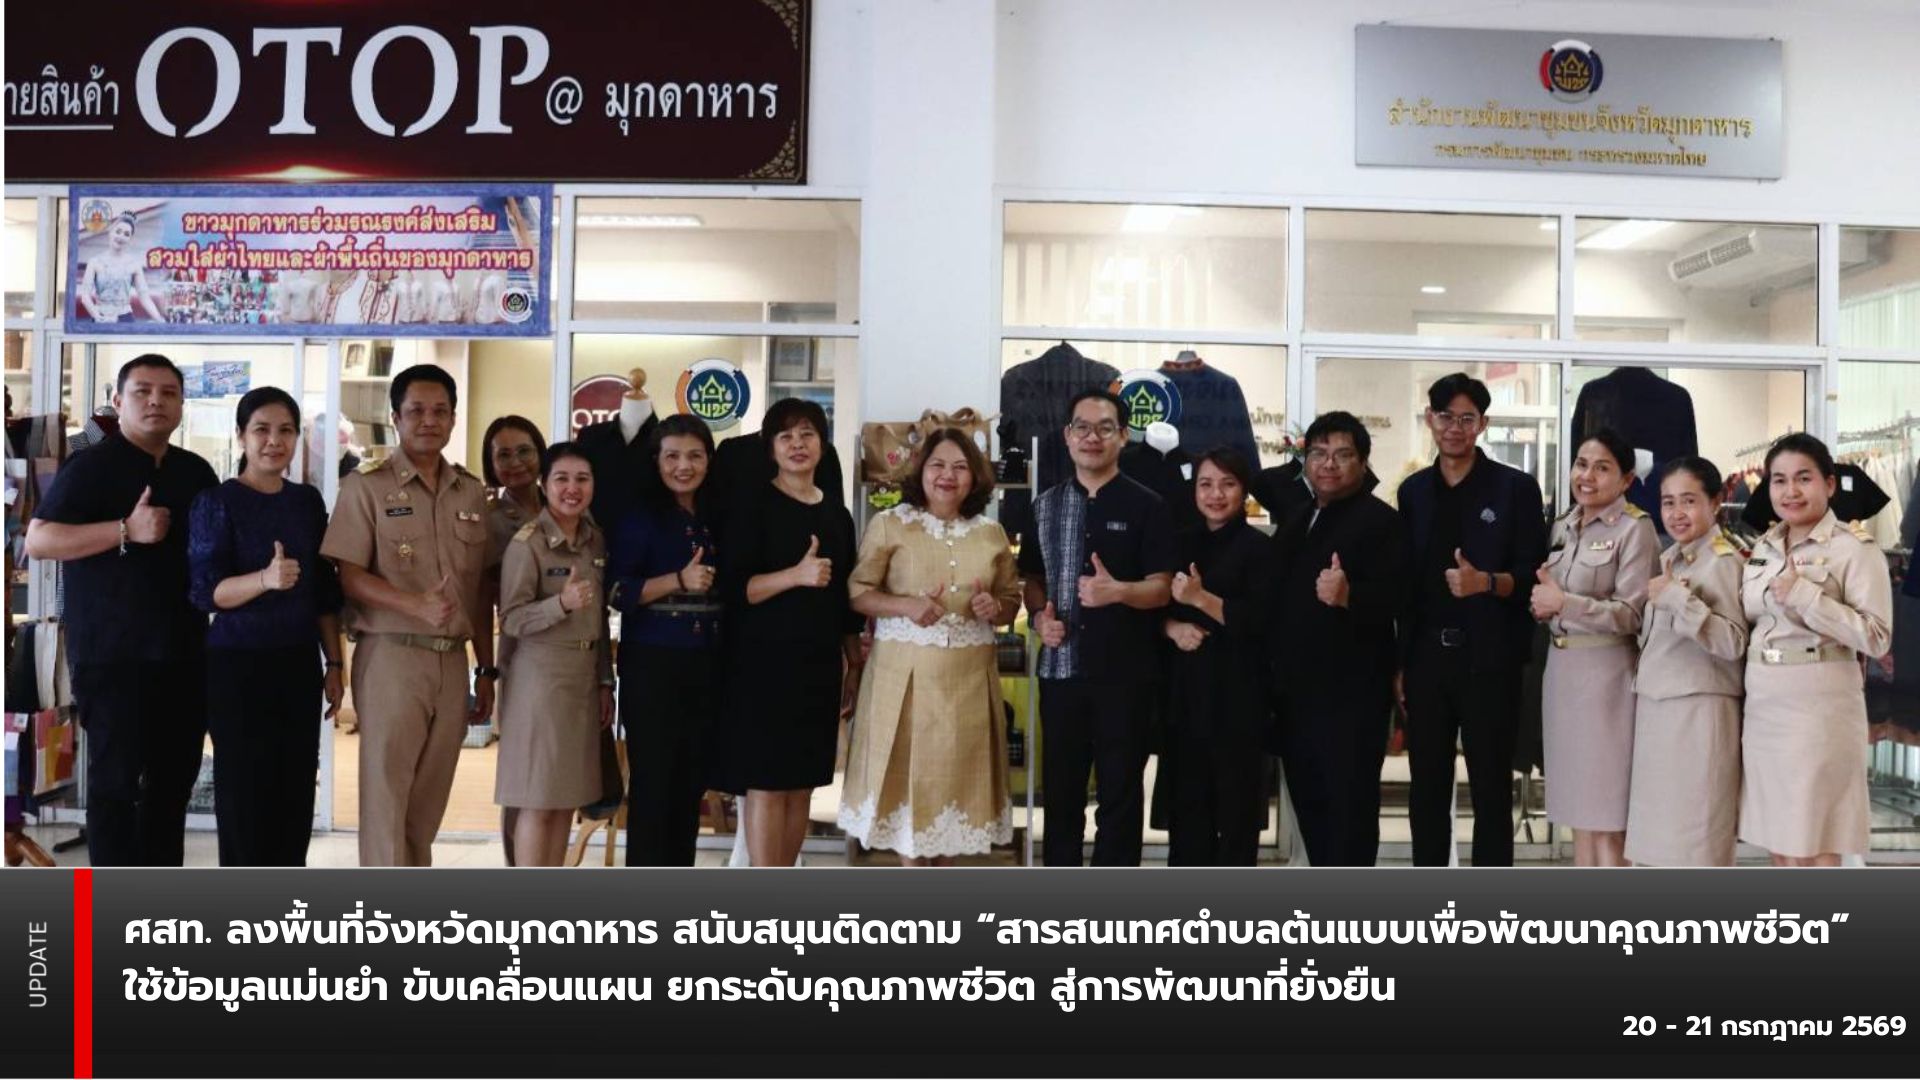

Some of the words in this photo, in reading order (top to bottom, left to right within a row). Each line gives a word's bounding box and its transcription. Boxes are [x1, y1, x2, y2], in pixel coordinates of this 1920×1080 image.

[135, 26, 551, 138] OTOP
[546, 76, 583, 125] @
[606, 82, 778, 136] มุกดาหาร
